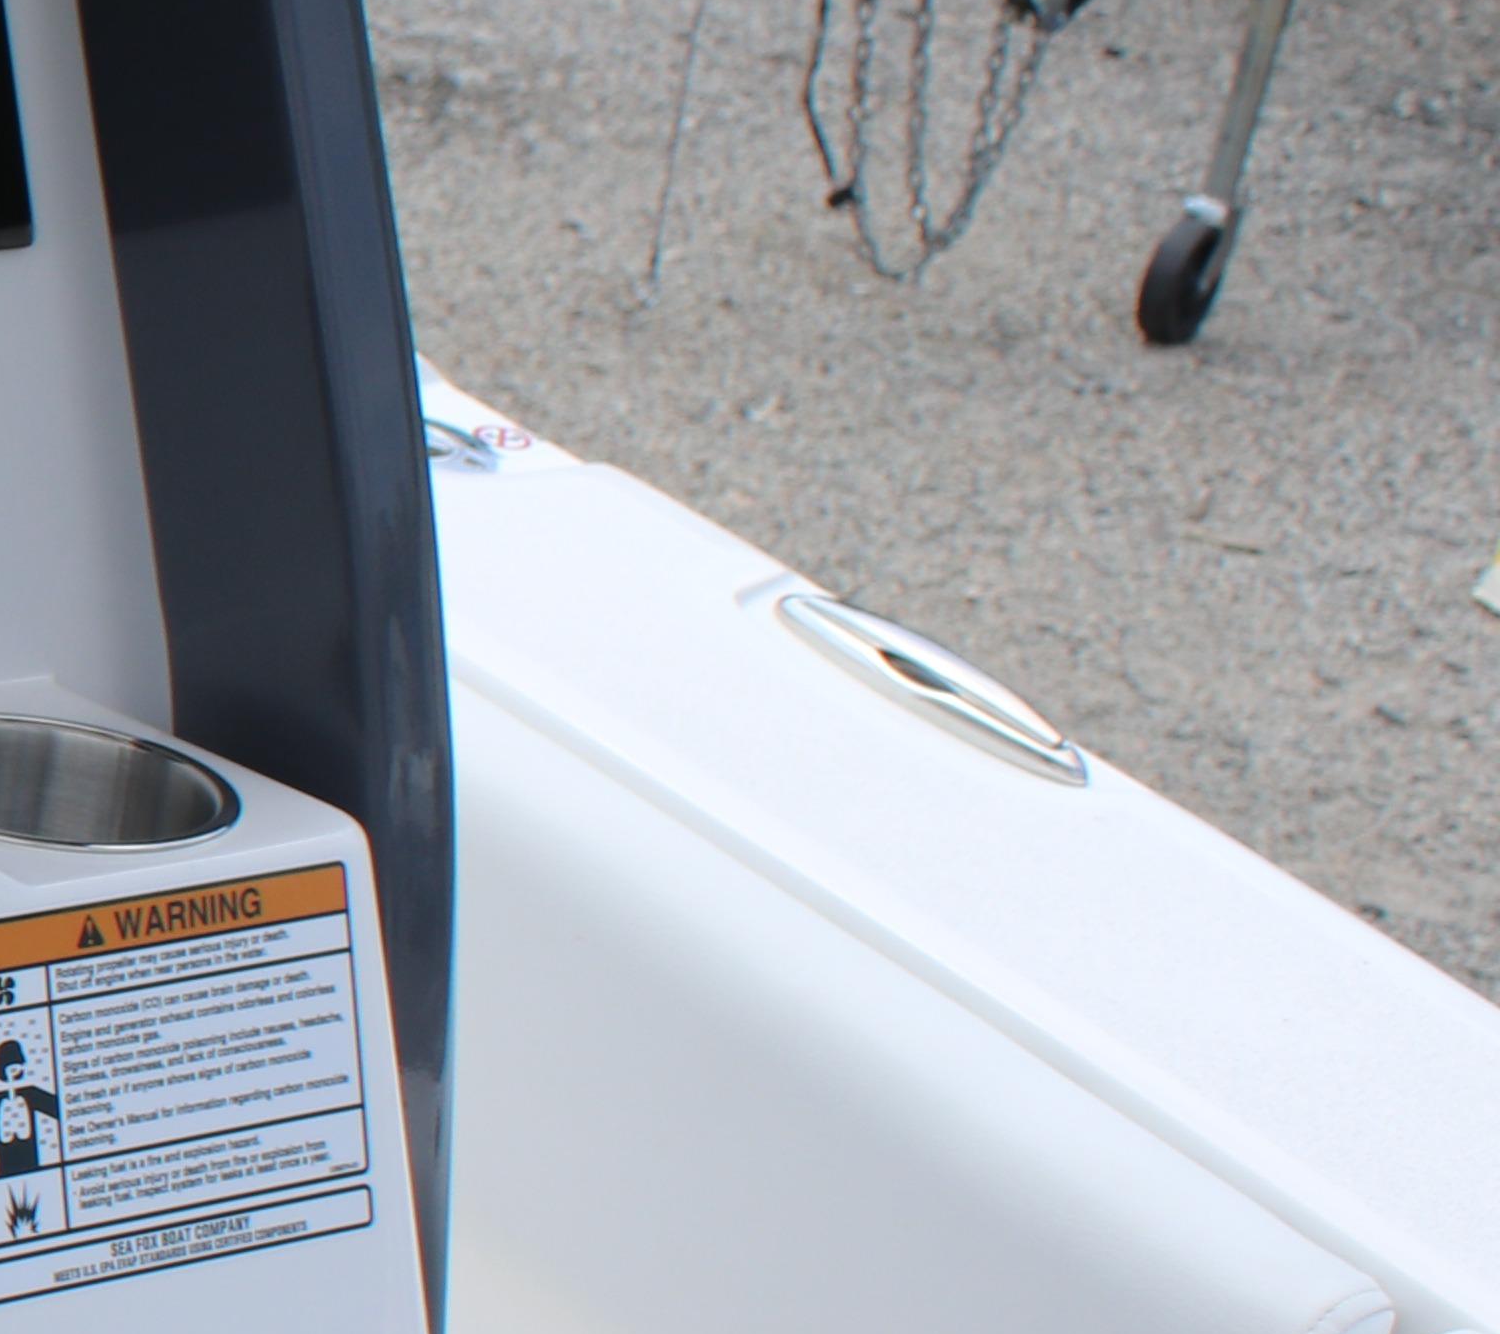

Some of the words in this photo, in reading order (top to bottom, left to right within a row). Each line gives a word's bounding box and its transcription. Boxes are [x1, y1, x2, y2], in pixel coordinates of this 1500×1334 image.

[114, 887, 261, 940] WARNING
[109, 1237, 134, 1258] SEA
[135, 1234, 159, 1252] FOX
[161, 1226, 192, 1247] BOAT
[194, 1215, 250, 1240] COMPANY
